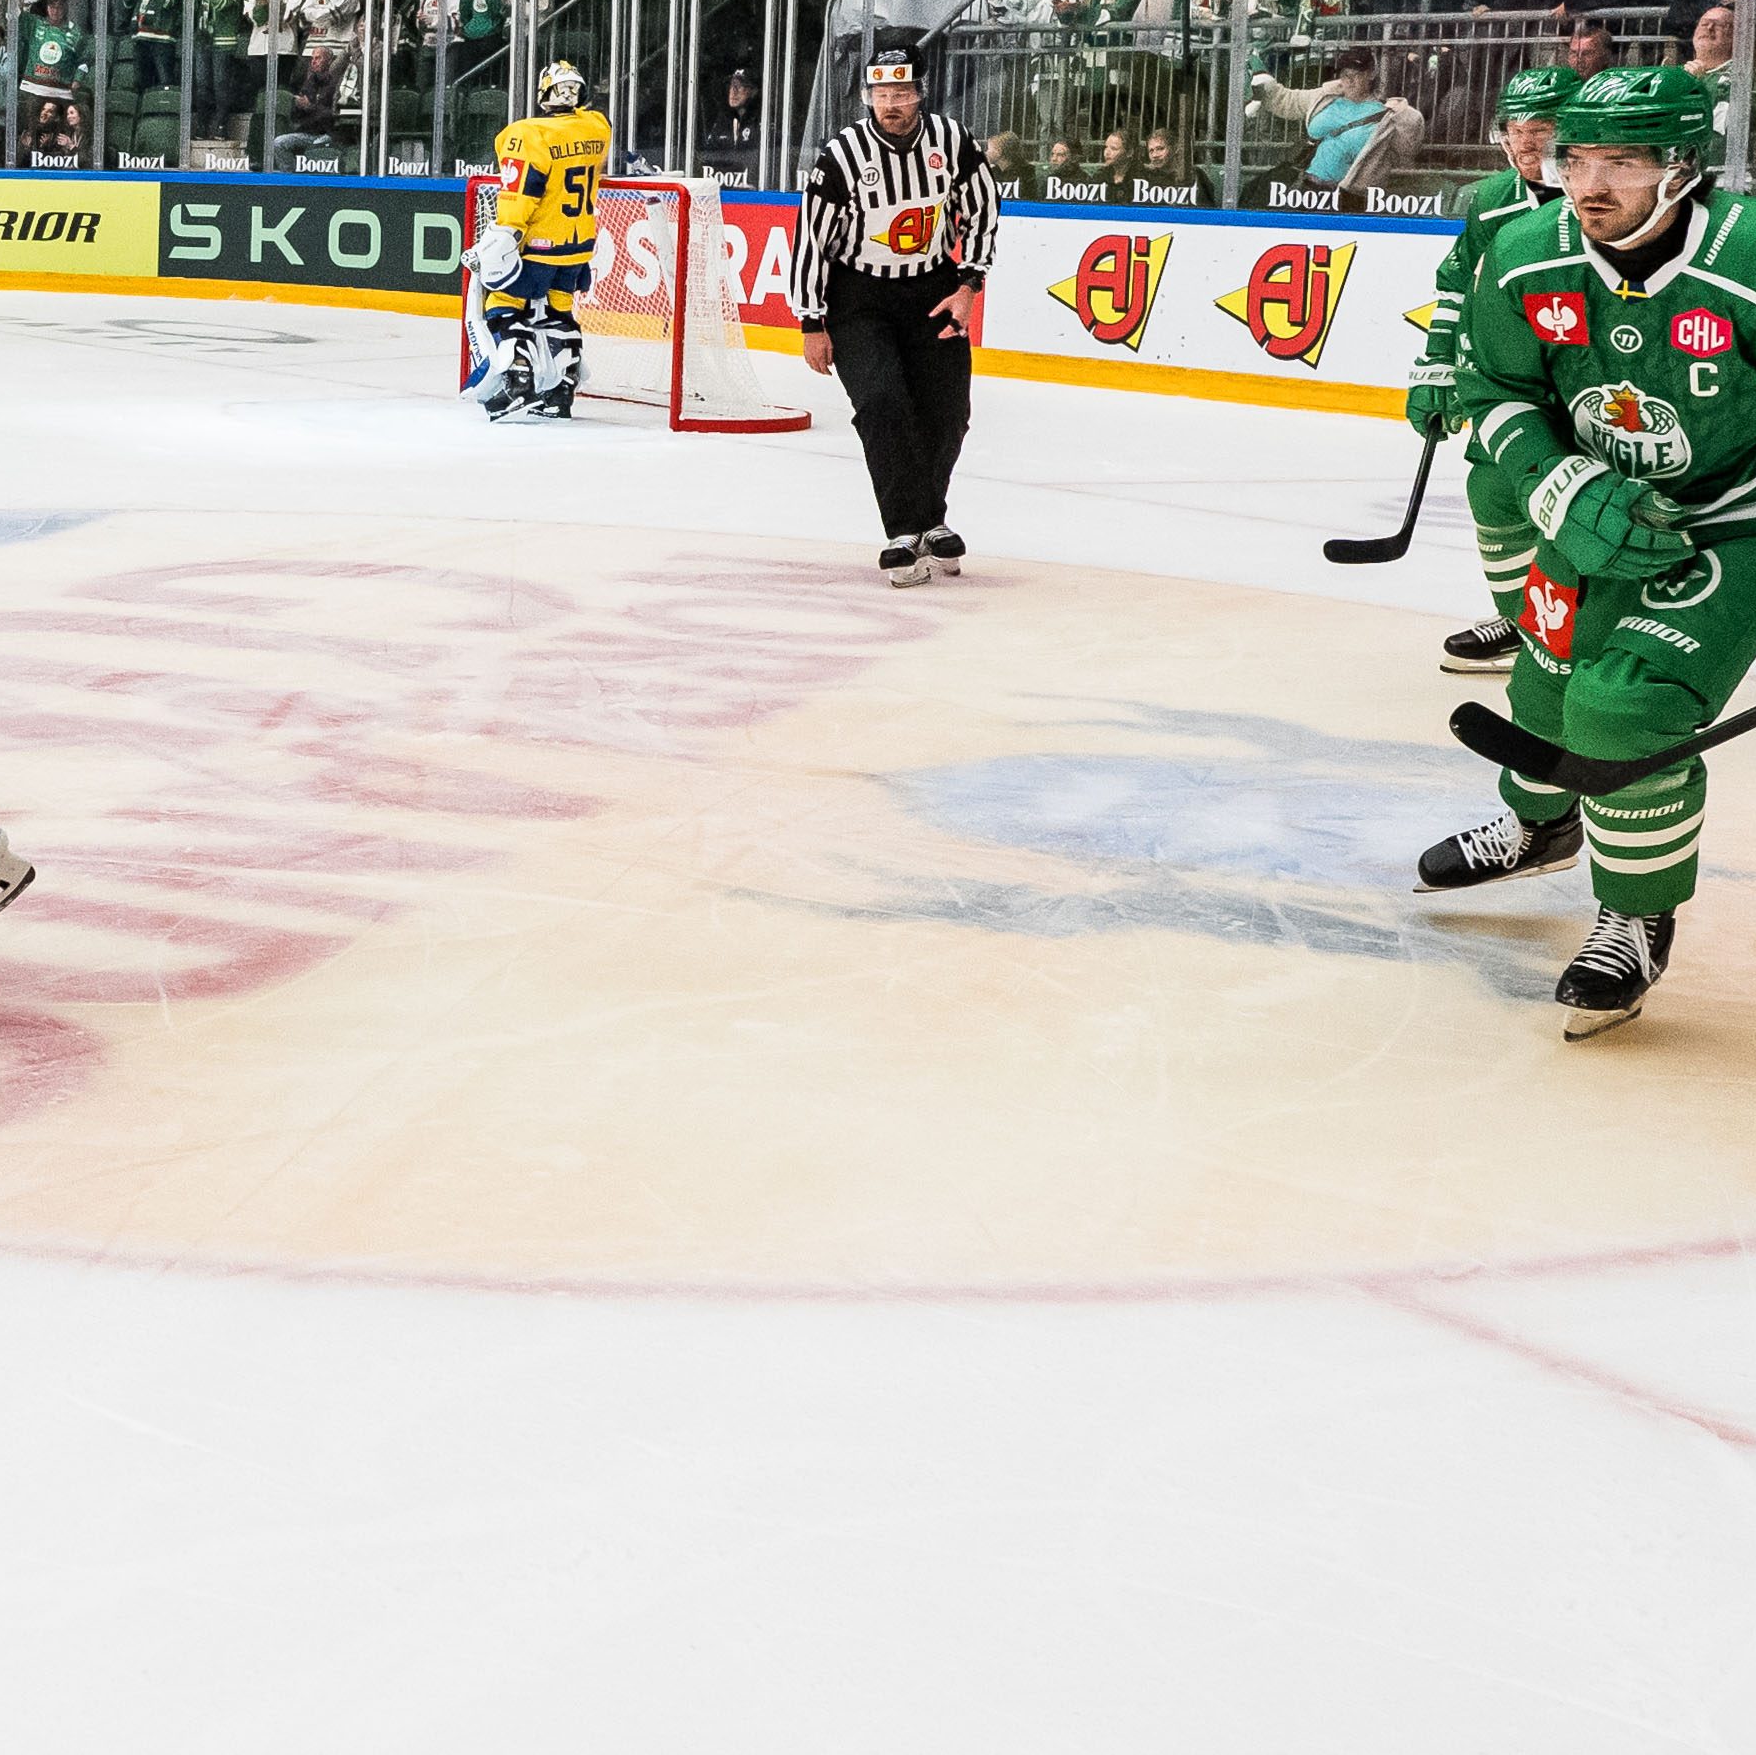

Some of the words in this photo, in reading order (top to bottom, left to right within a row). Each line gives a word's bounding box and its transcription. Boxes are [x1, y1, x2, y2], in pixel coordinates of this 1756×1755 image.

[507, 137, 522, 153] 51
[30, 151, 80, 169] Boozt
[118, 152, 166, 170] Boozt
[204, 153, 251, 171] Boozt
[295, 155, 341, 174] Boozt
[387, 157, 431, 176] Boozt
[455, 158, 497, 177] Boozt
[702, 165, 749, 189] Boozt
[810, 167, 826, 186] 45
[1046, 175, 1107, 203] Boozt
[561, 164, 596, 218] 51
[1133, 178, 1197, 206] Boozt
[1269, 181, 1341, 211] Boozt
[1366, 185, 1444, 216] Boozt
[1704, 202, 1744, 266] WARRIOR
[1677, 315, 1727, 353] CHL
[1689, 361, 1720, 398] C
[1580, 794, 1686, 821] WARRIOR
